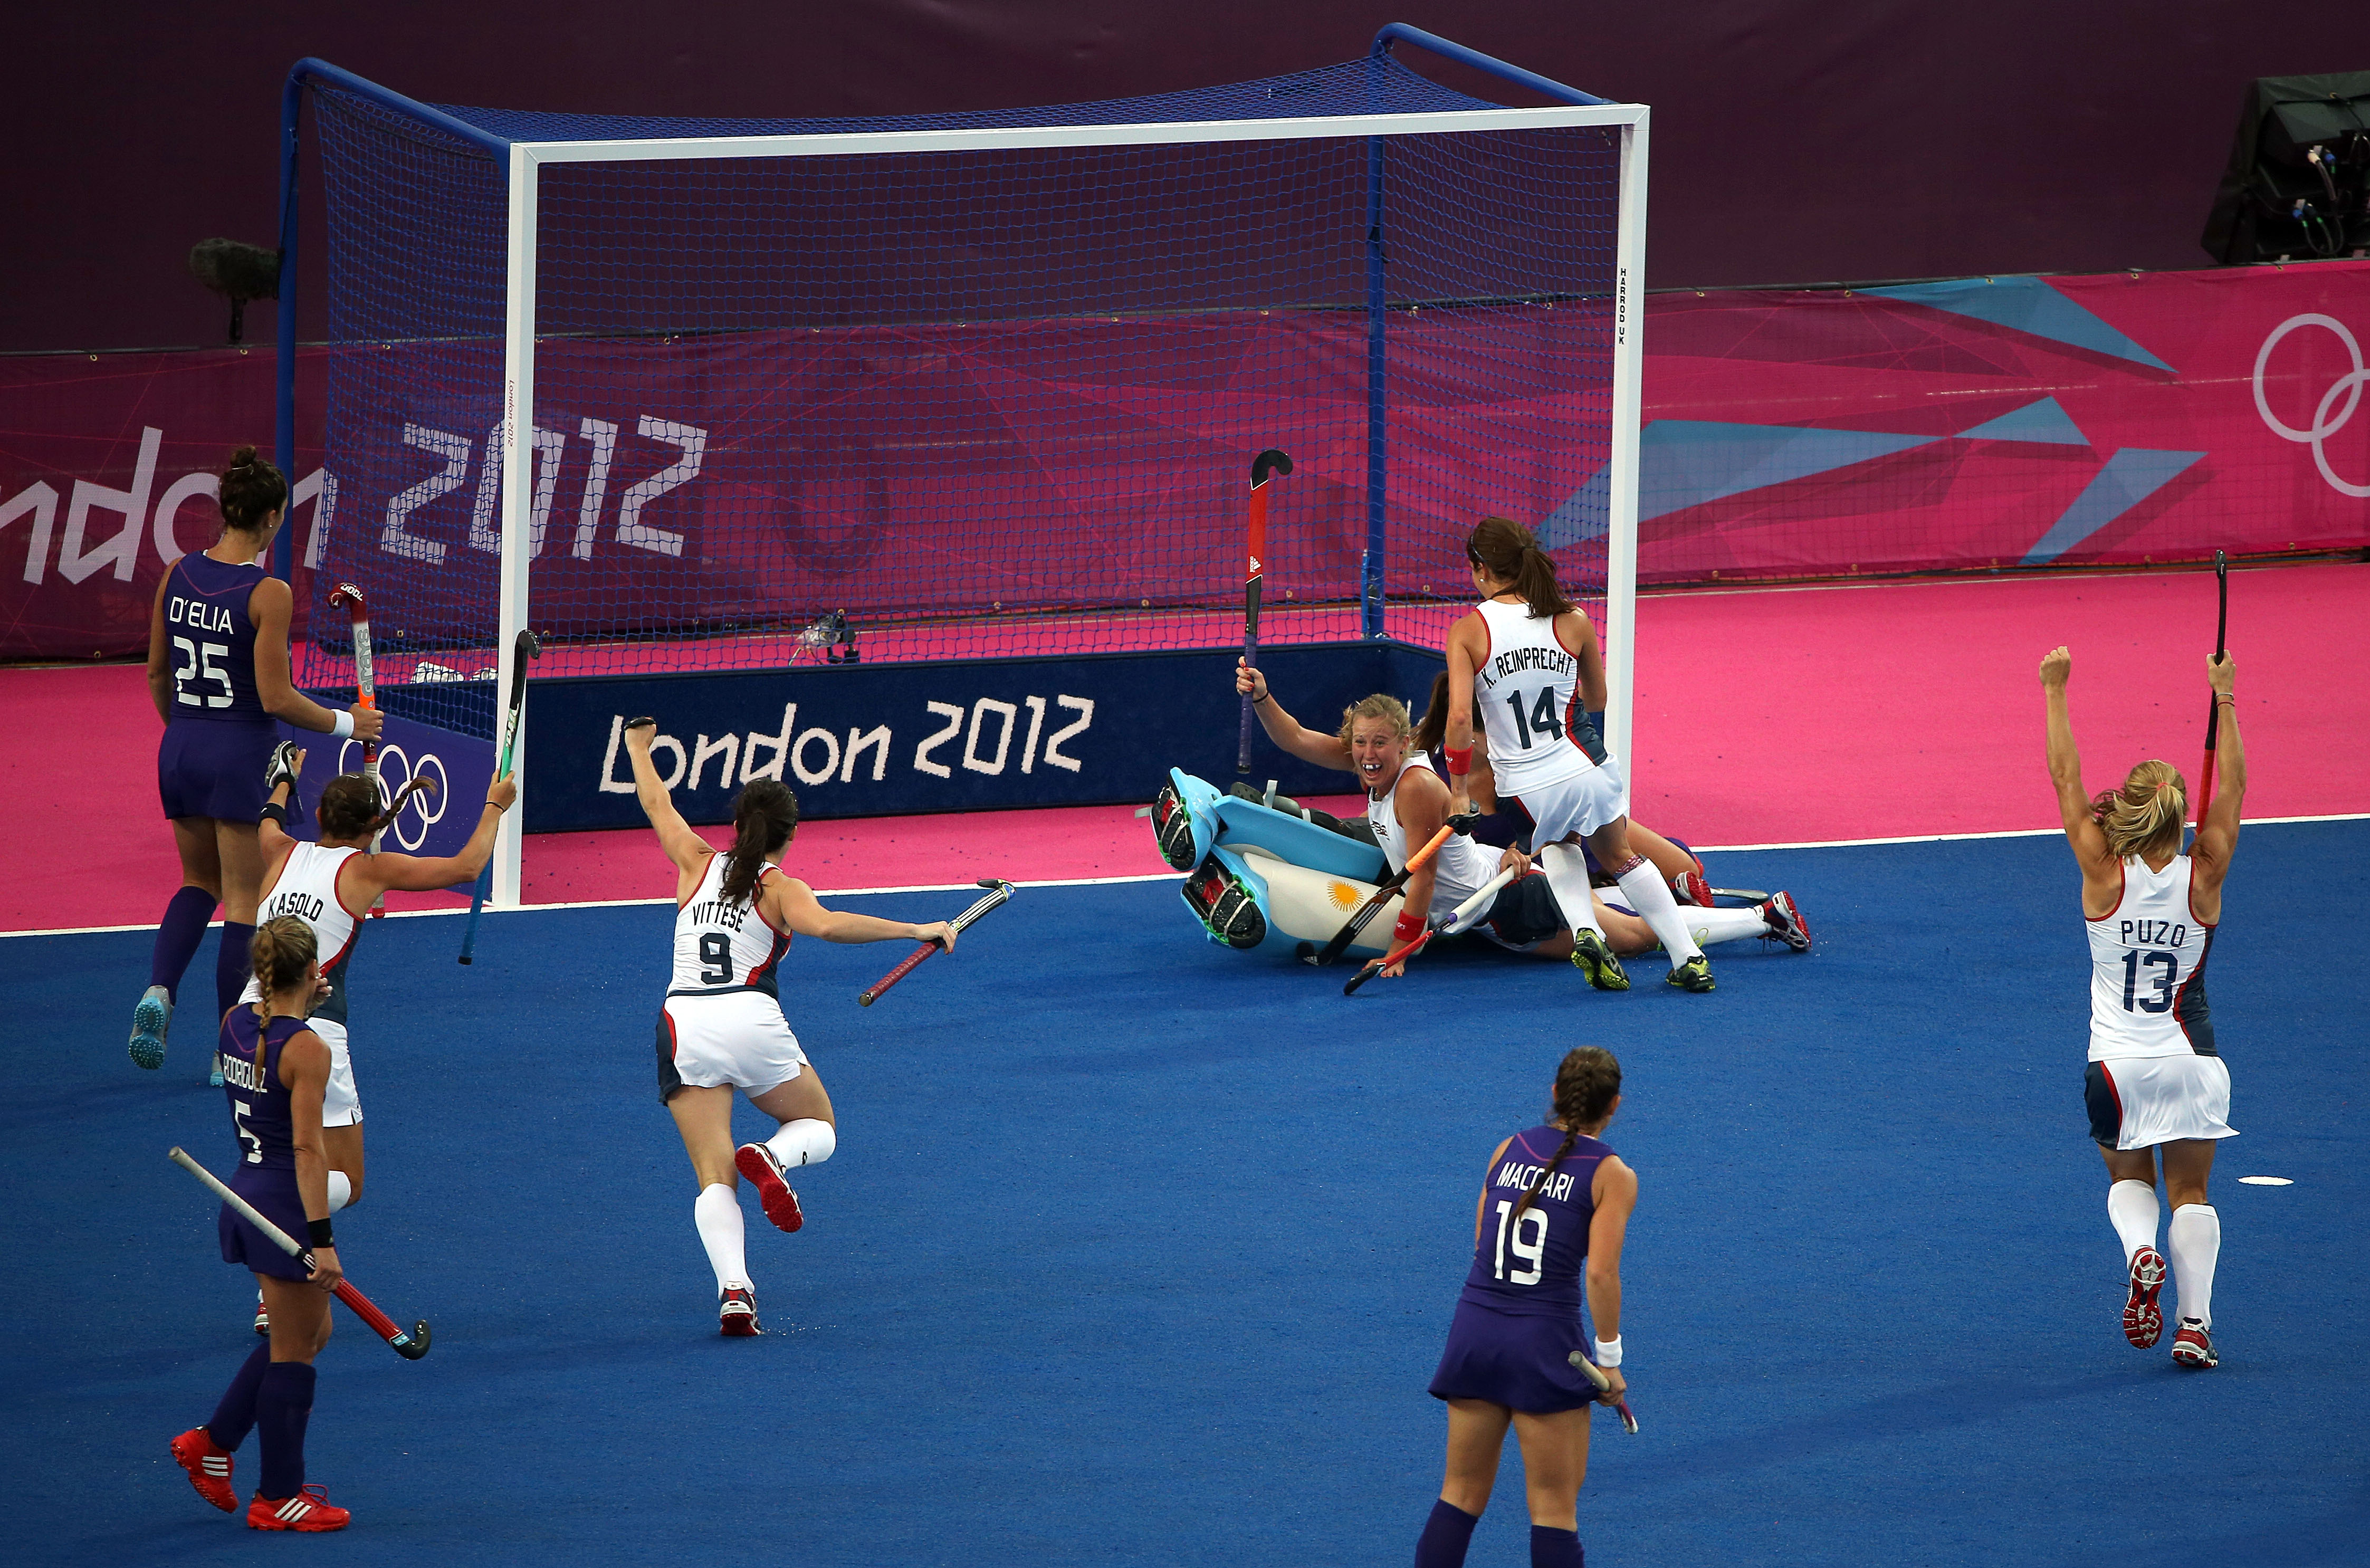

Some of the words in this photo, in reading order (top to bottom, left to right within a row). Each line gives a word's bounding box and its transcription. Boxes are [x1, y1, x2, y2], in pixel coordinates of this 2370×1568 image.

[1619, 327, 1624, 345] UK
[381, 414, 707, 565] 2012
[169, 596, 234, 634] D'ELIA
[174, 635, 233, 707] 25
[1481, 668, 1497, 689] K.
[1495, 648, 1573, 678] REINPRECHT
[599, 702, 892, 793] London
[914, 694, 1095, 778] 2012
[1507, 686, 1562, 749] 14
[268, 893, 323, 921] KASOLD
[693, 902, 747, 933] VITTESE
[2121, 920, 2185, 948] PUZO
[700, 933, 733, 984] 9
[2121, 950, 2178, 1012] 13
[235, 1099, 263, 1163] 5
[1495, 1200, 1548, 1285] 19
